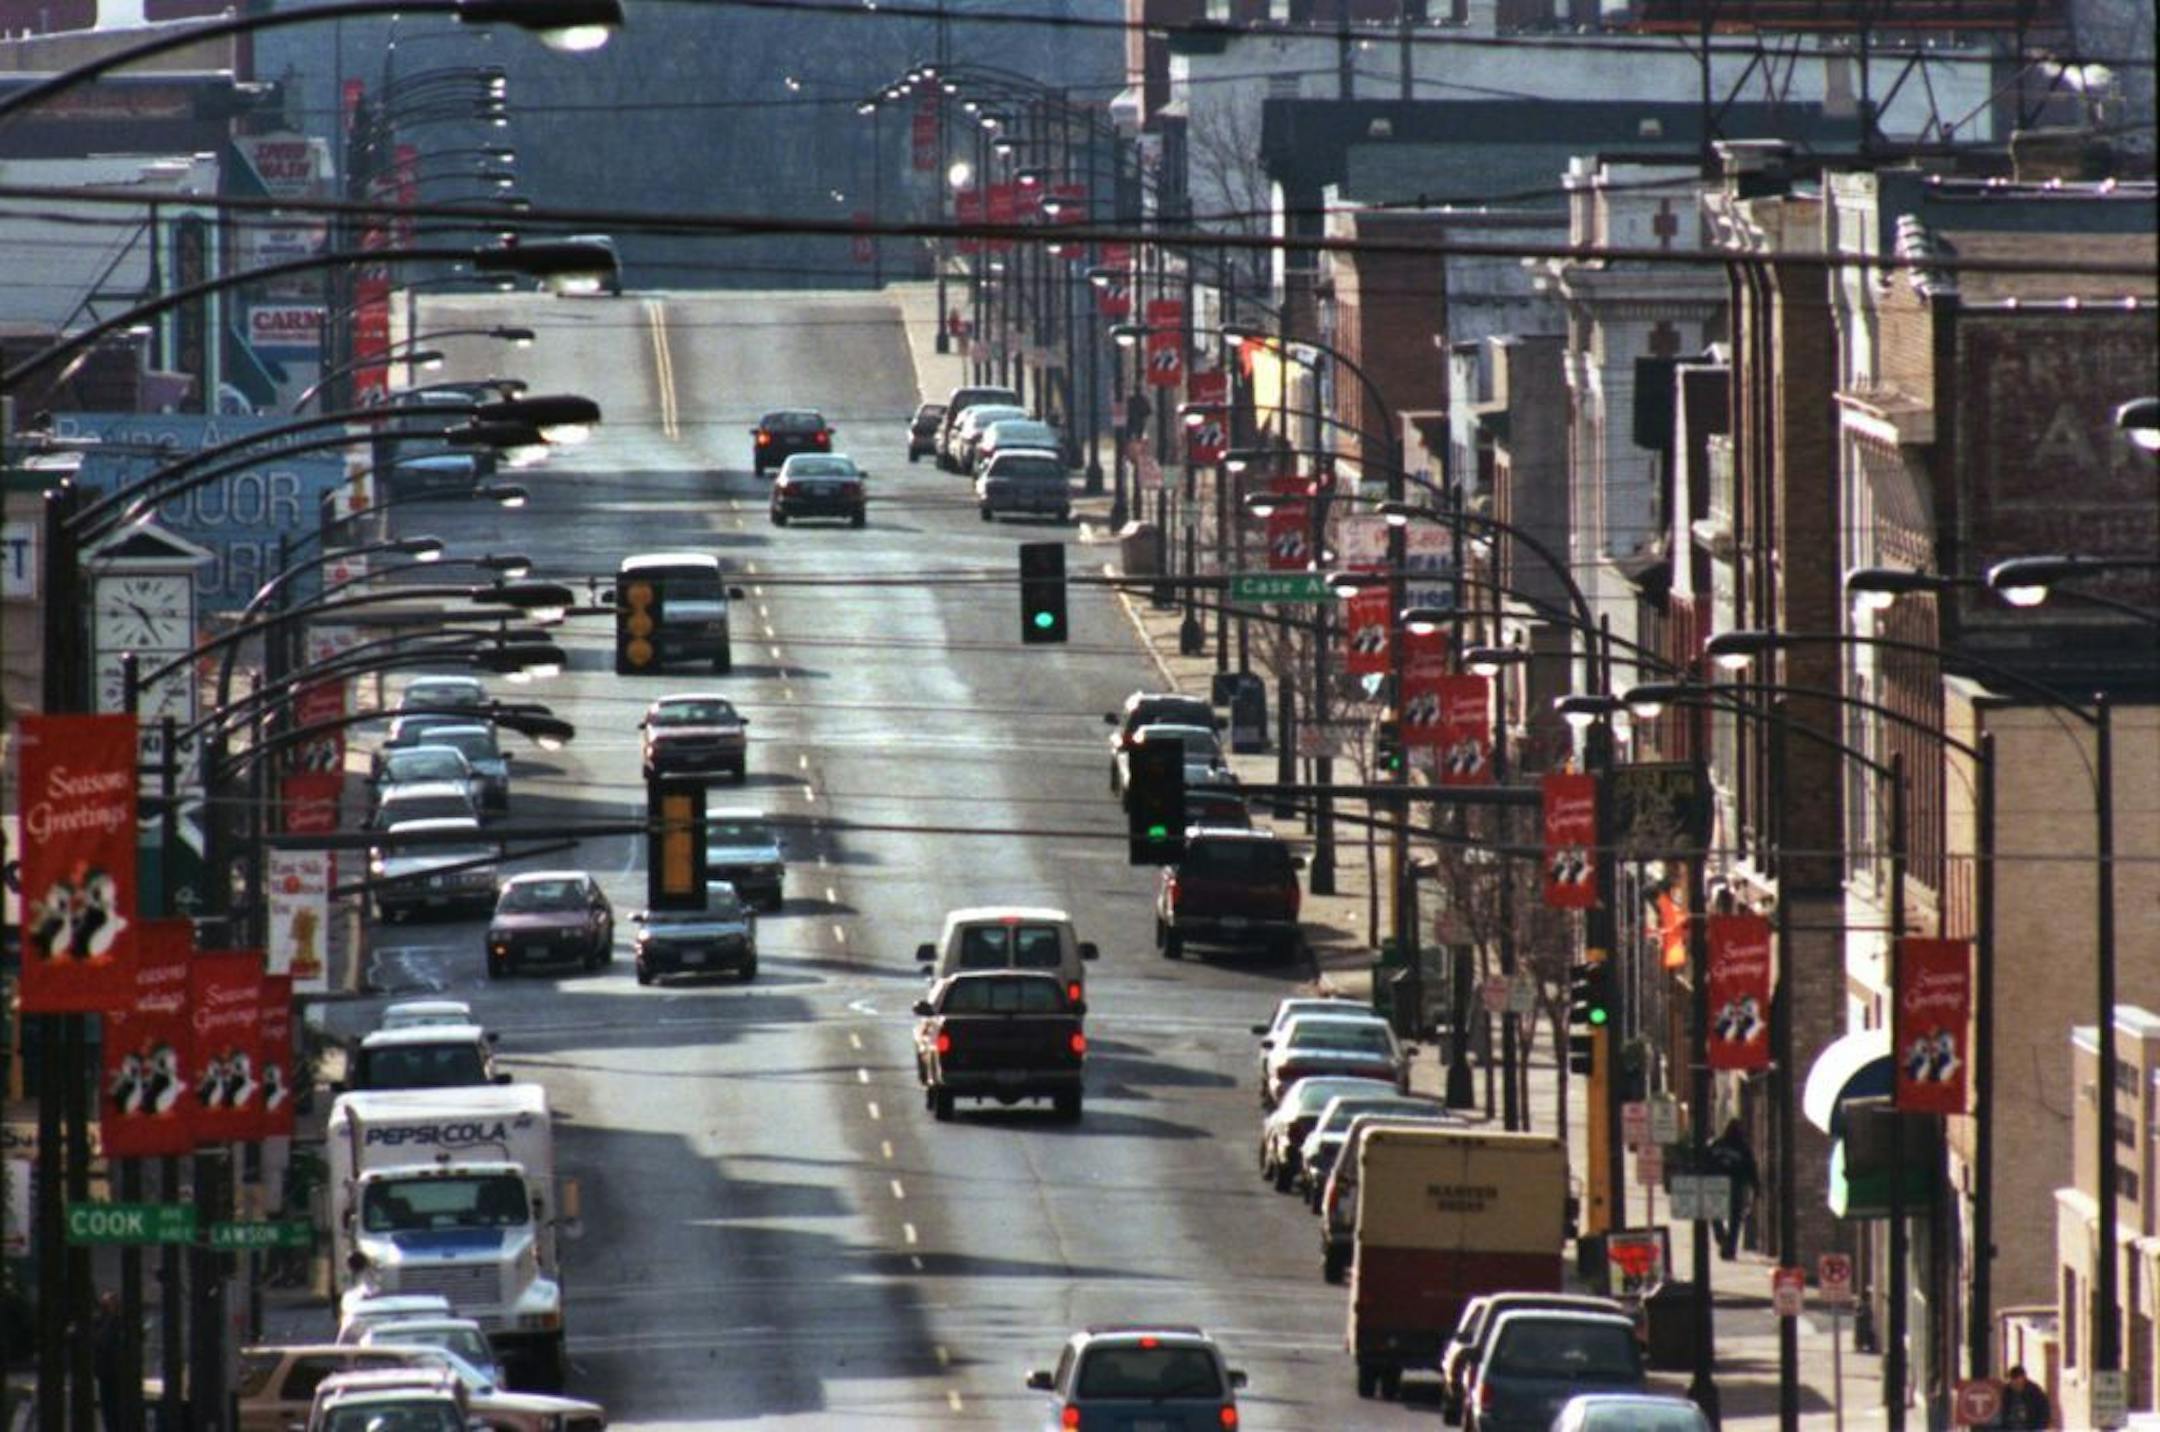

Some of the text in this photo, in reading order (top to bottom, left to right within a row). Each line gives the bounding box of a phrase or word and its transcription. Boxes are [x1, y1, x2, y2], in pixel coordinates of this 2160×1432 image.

[122, 470, 299, 526] QUOR
[1242, 580, 1292, 594] Case
[70, 1210, 145, 1236] COOK
[209, 1226, 278, 1244] LAWSON
